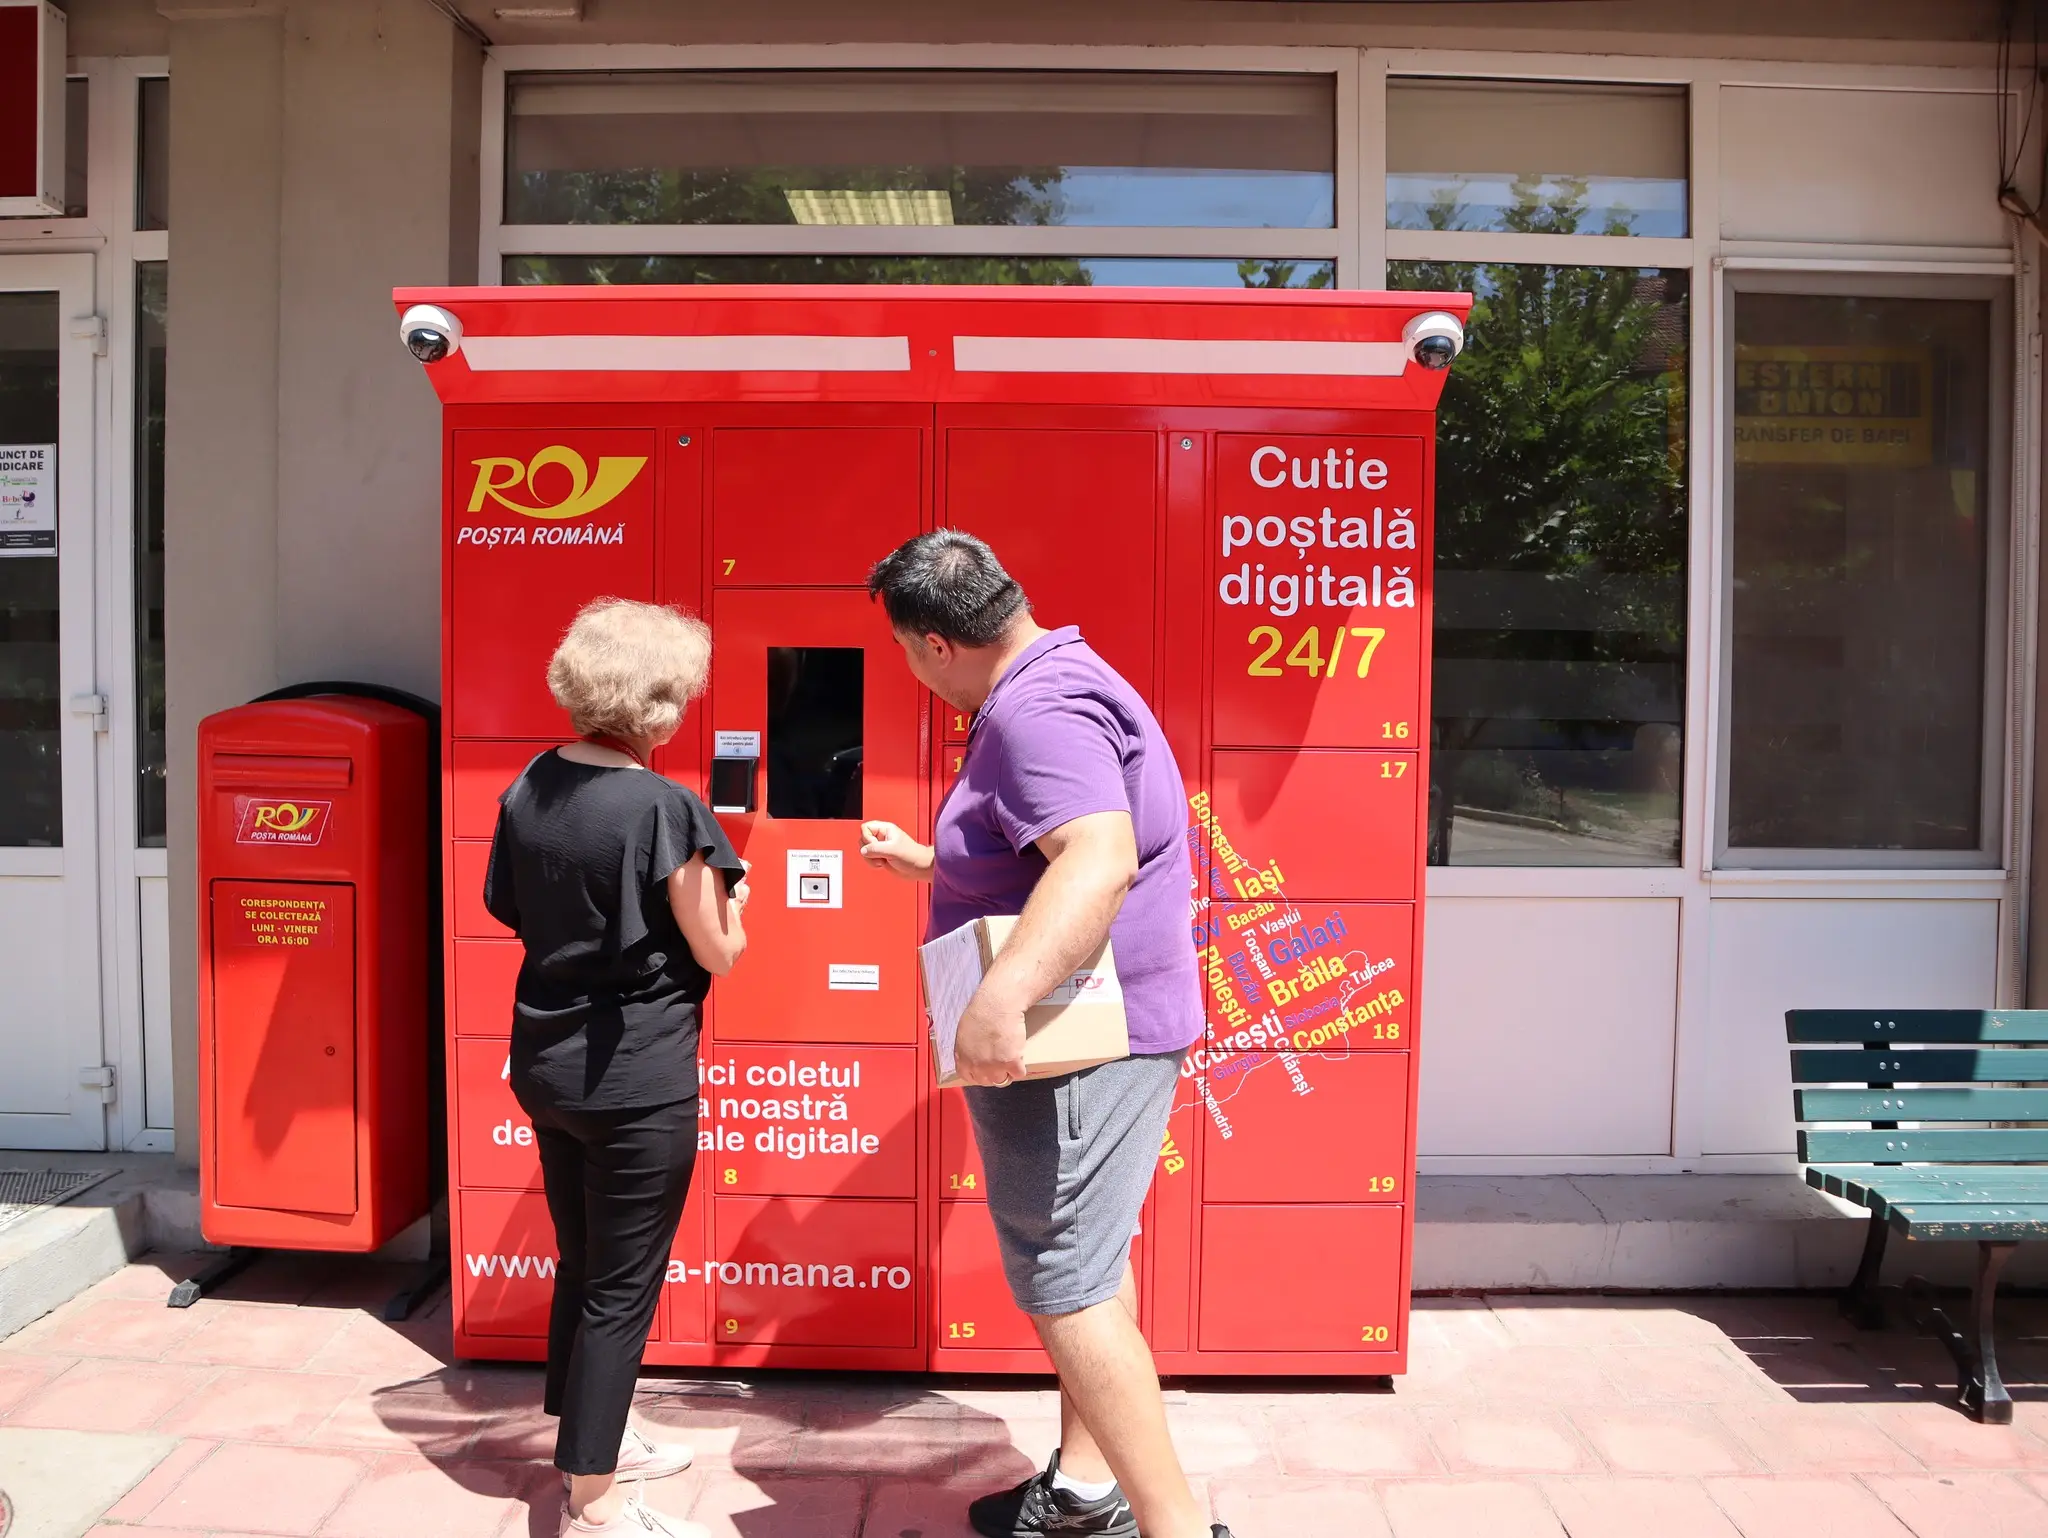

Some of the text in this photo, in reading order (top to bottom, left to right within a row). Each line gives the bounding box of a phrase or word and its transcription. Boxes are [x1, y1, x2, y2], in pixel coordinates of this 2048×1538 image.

[1736, 363, 1882, 388] ESTERN
[1759, 389, 1883, 415] UNION
[1734, 427, 1823, 443] RANSFER
[1831, 427, 1855, 443] DE
[0, 450, 44, 459] UNCT DE
[0, 462, 44, 471] IDICARE
[1250, 445, 1388, 490] Cutie
[457, 523, 626, 550] POȘTA ROMÂNĂ
[1222, 507, 1416, 560] poștală
[722, 559, 736, 576] 7
[1219, 563, 1415, 617] digitală
[1247, 626, 1386, 679] 24/7
[954, 714, 971, 731] 1
[1382, 721, 1409, 739] 16
[1381, 761, 1408, 778] 17
[250, 831, 277, 841] POȘTA
[1233, 859, 1285, 902] Iași
[240, 898, 326, 911] CORESPONDENȚA
[245, 911, 322, 922] SE COLECTEAZĂ
[1226, 900, 1276, 931] Bacău
[251, 923, 275, 933] LUNI
[284, 924, 319, 934] VINERI
[1260, 908, 1302, 936] Vaslui
[257, 935, 309, 946] ORA 16:00
[1269, 911, 1349, 966] Galați
[1241, 928, 1277, 980] Focșani
[1227, 950, 1262, 1004] Buzău
[1267, 955, 1348, 1008] Brăila
[1349, 957, 1396, 986] Tulcea
[1197, 944, 1252, 1029] Ploiești
[1292, 988, 1405, 1053] Constanța
[1372, 1023, 1400, 1040] 18
[1180, 1008, 1285, 1079] ucurești
[698, 1057, 860, 1088] ici coletul
[1212, 1051, 1261, 1081] Giurgiu
[720, 1093, 848, 1121] noastră
[1194, 1077, 1233, 1141] Alexandria
[492, 1119, 881, 1159] de ale digitale
[724, 1168, 738, 1185] 8
[949, 1173, 977, 1190] 14
[1368, 1176, 1396, 1193] 19
[725, 1318, 739, 1334] 9
[949, 1322, 976, 1339] 15
[1361, 1325, 1389, 1342] 20
